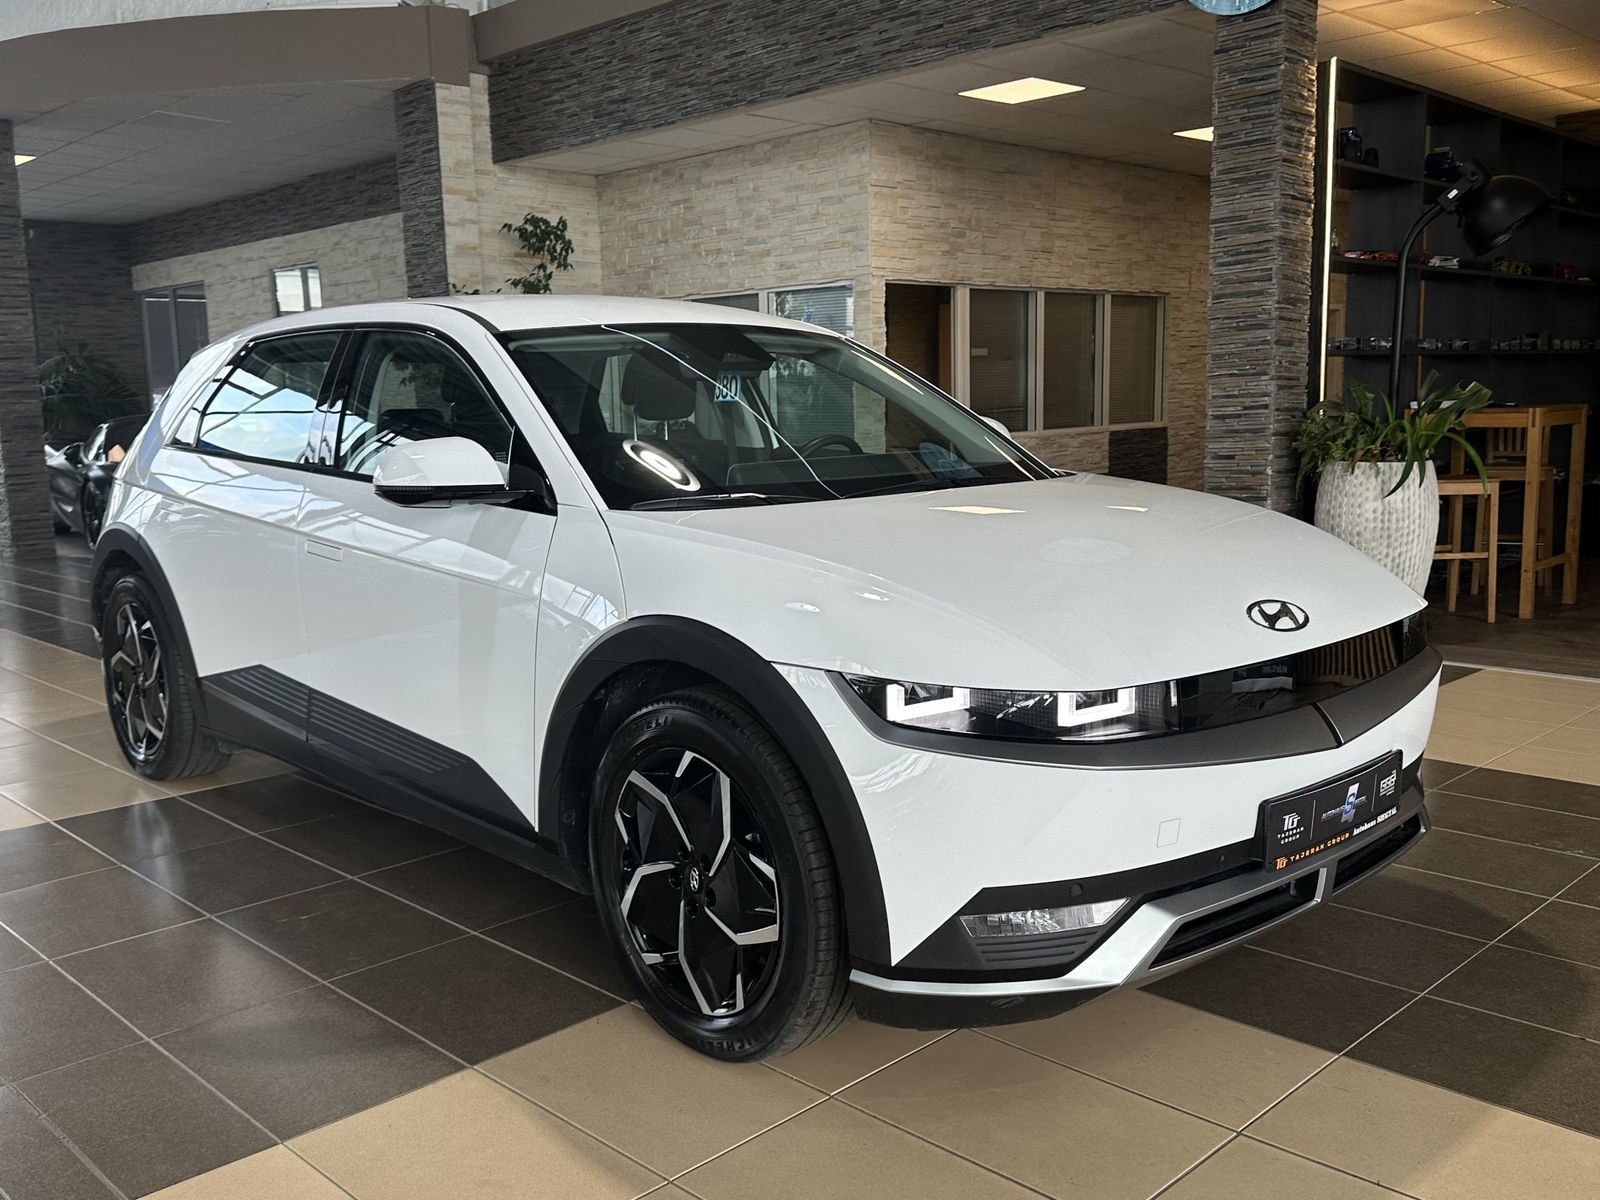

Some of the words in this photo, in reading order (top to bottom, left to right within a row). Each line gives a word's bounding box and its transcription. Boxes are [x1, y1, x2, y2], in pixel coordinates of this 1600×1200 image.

[1290, 843, 1325, 862] TAJERAN
[1327, 832, 1350, 847] GROUP
[1353, 820, 1377, 836] Autohaus
